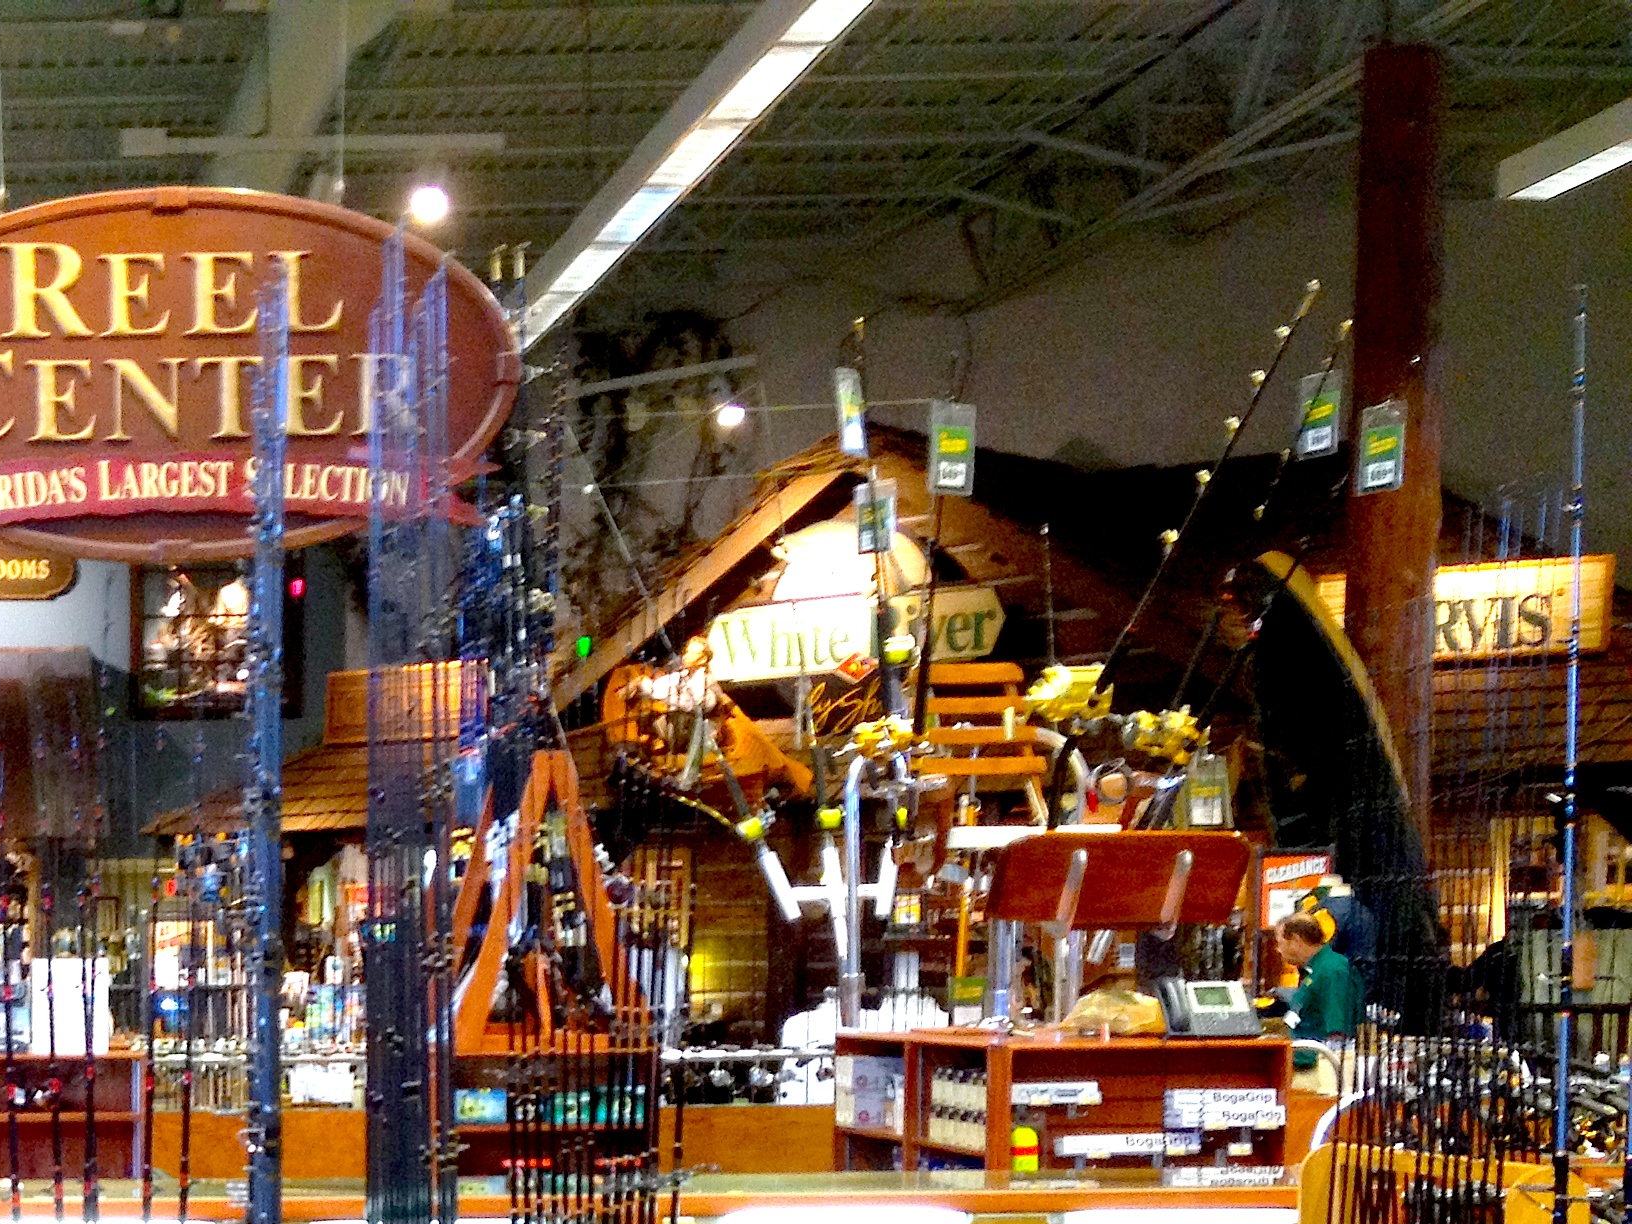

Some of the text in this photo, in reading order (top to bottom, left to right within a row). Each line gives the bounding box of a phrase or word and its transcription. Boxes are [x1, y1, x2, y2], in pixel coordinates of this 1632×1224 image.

[98, 460, 234, 501] LARGEST
[244, 456, 411, 507] SLECTION
[721, 618, 851, 669] White
[1435, 594, 1553, 651] RVIS
[1266, 856, 1327, 884] CLEARANCE
[1213, 1092, 1273, 1105] BogaGrip
